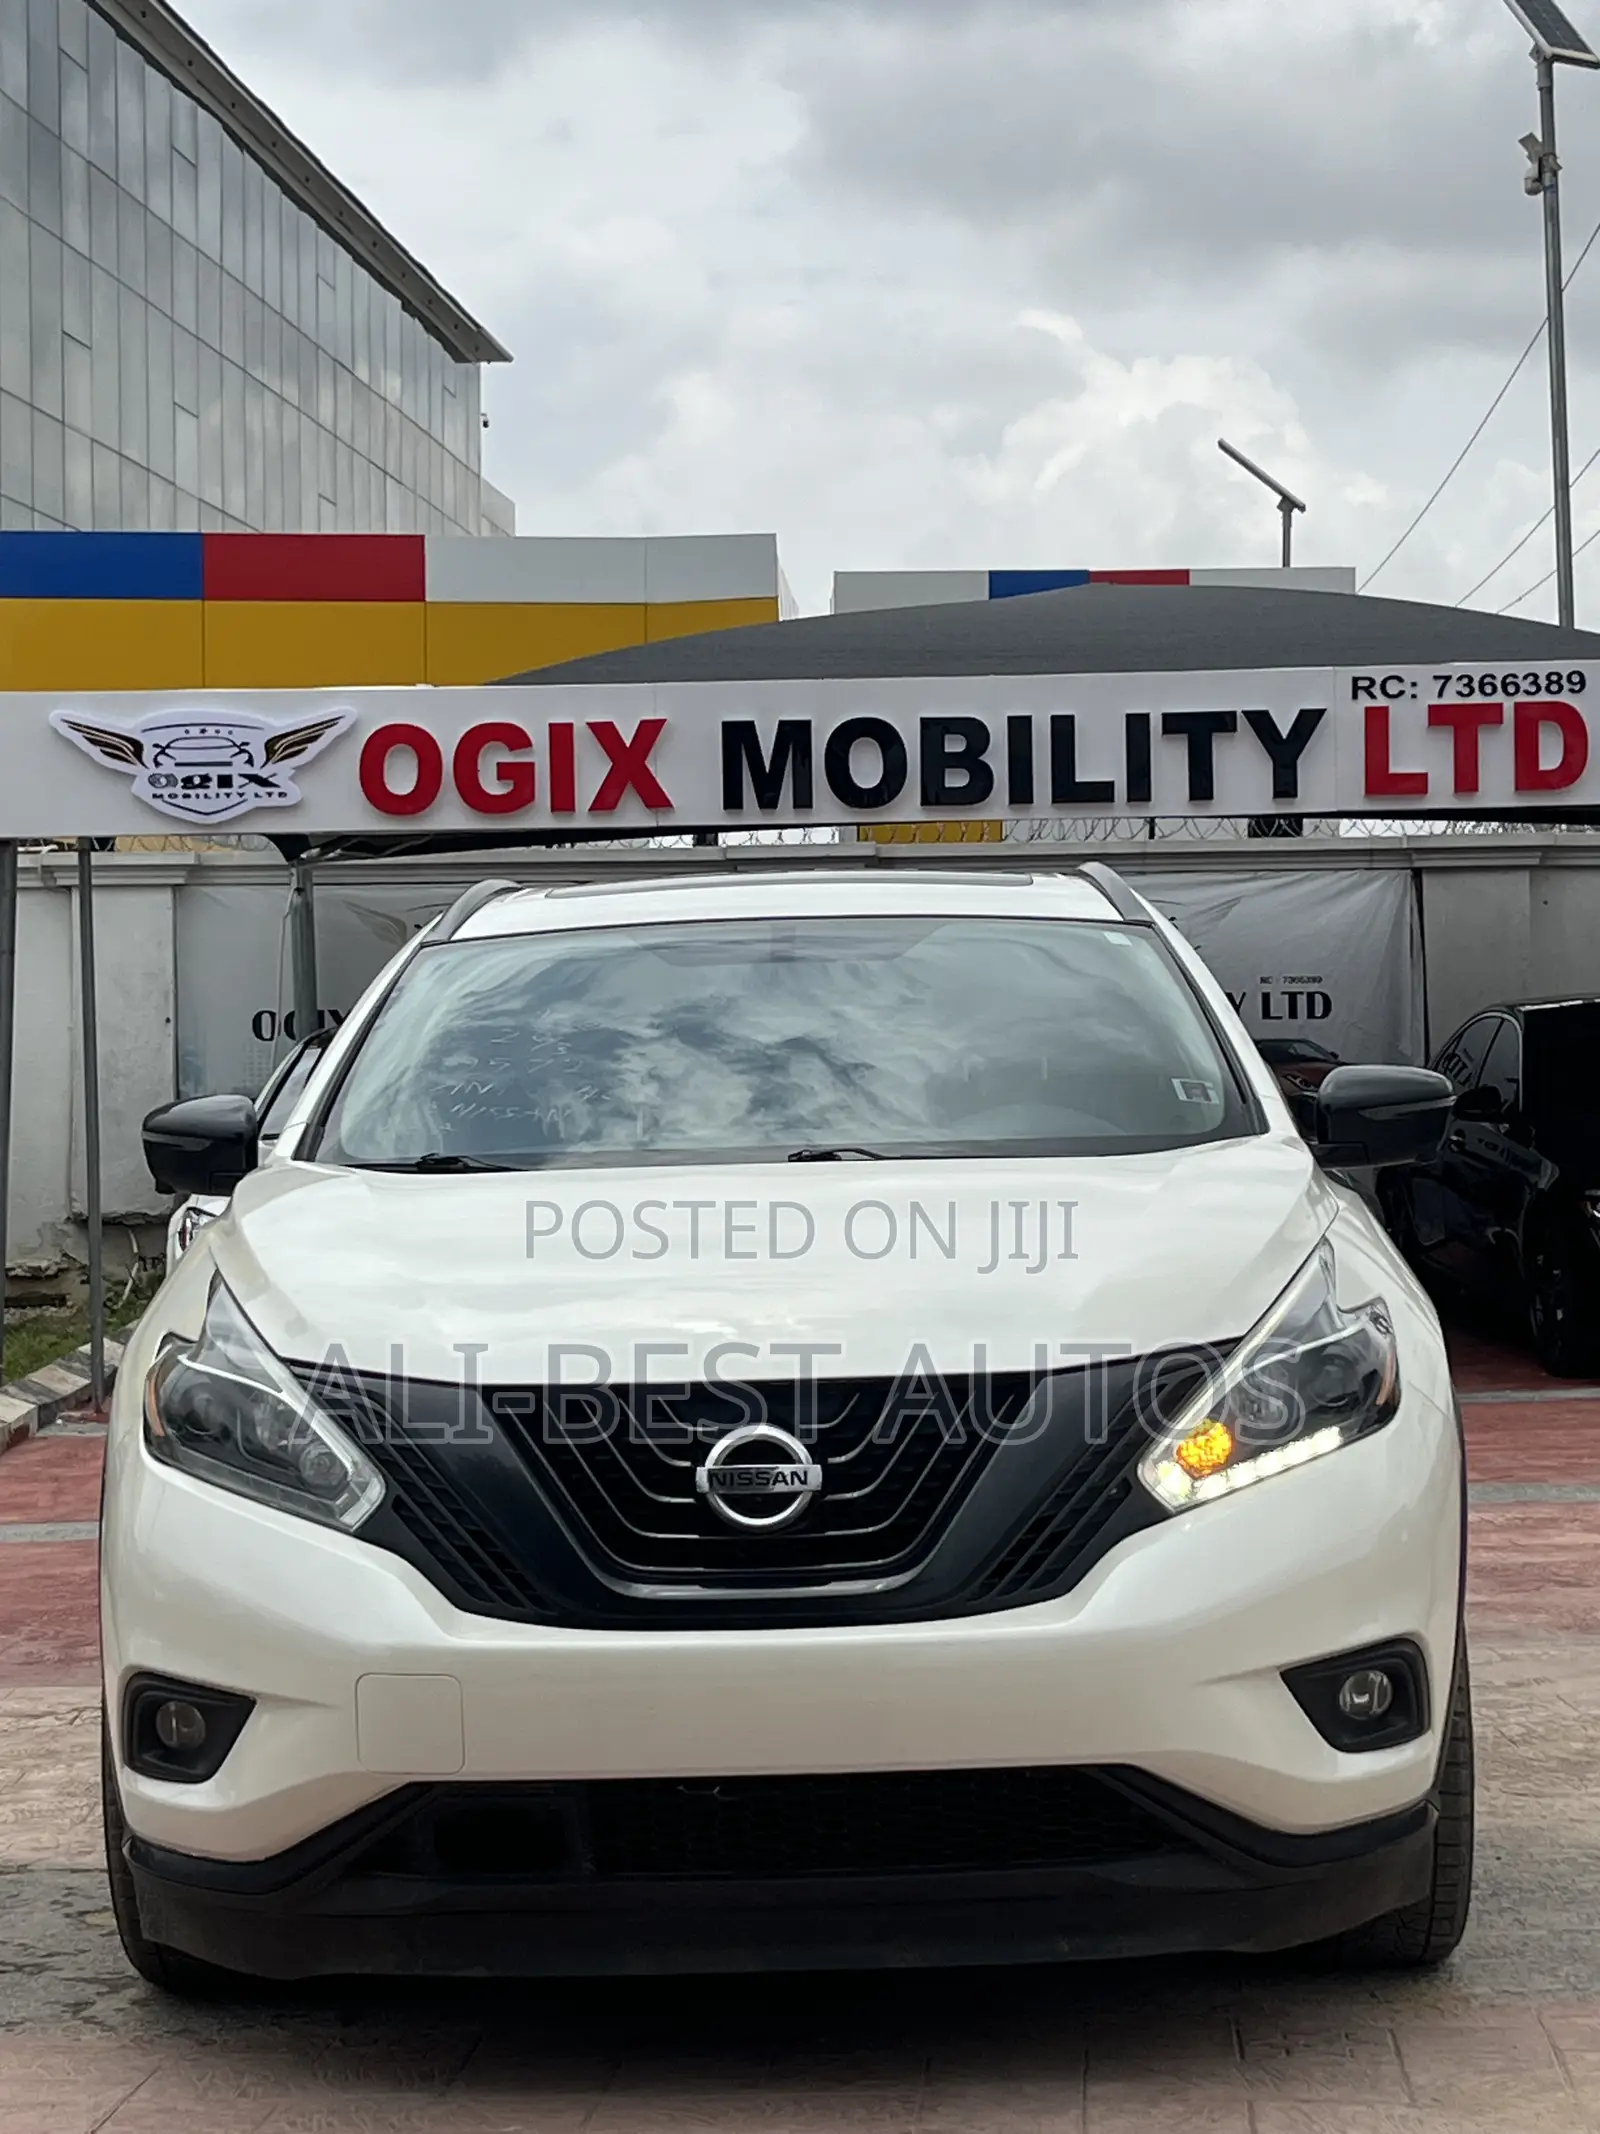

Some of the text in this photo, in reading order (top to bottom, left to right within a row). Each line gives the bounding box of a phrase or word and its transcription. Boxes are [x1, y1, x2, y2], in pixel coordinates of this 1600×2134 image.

[1351, 670, 1586, 700] RC: 7366389
[359, 701, 1589, 816] OGIX MOBILITY LTD
[1261, 991, 1332, 1020] LTD
[708, 1470, 808, 1486] NISSAN
